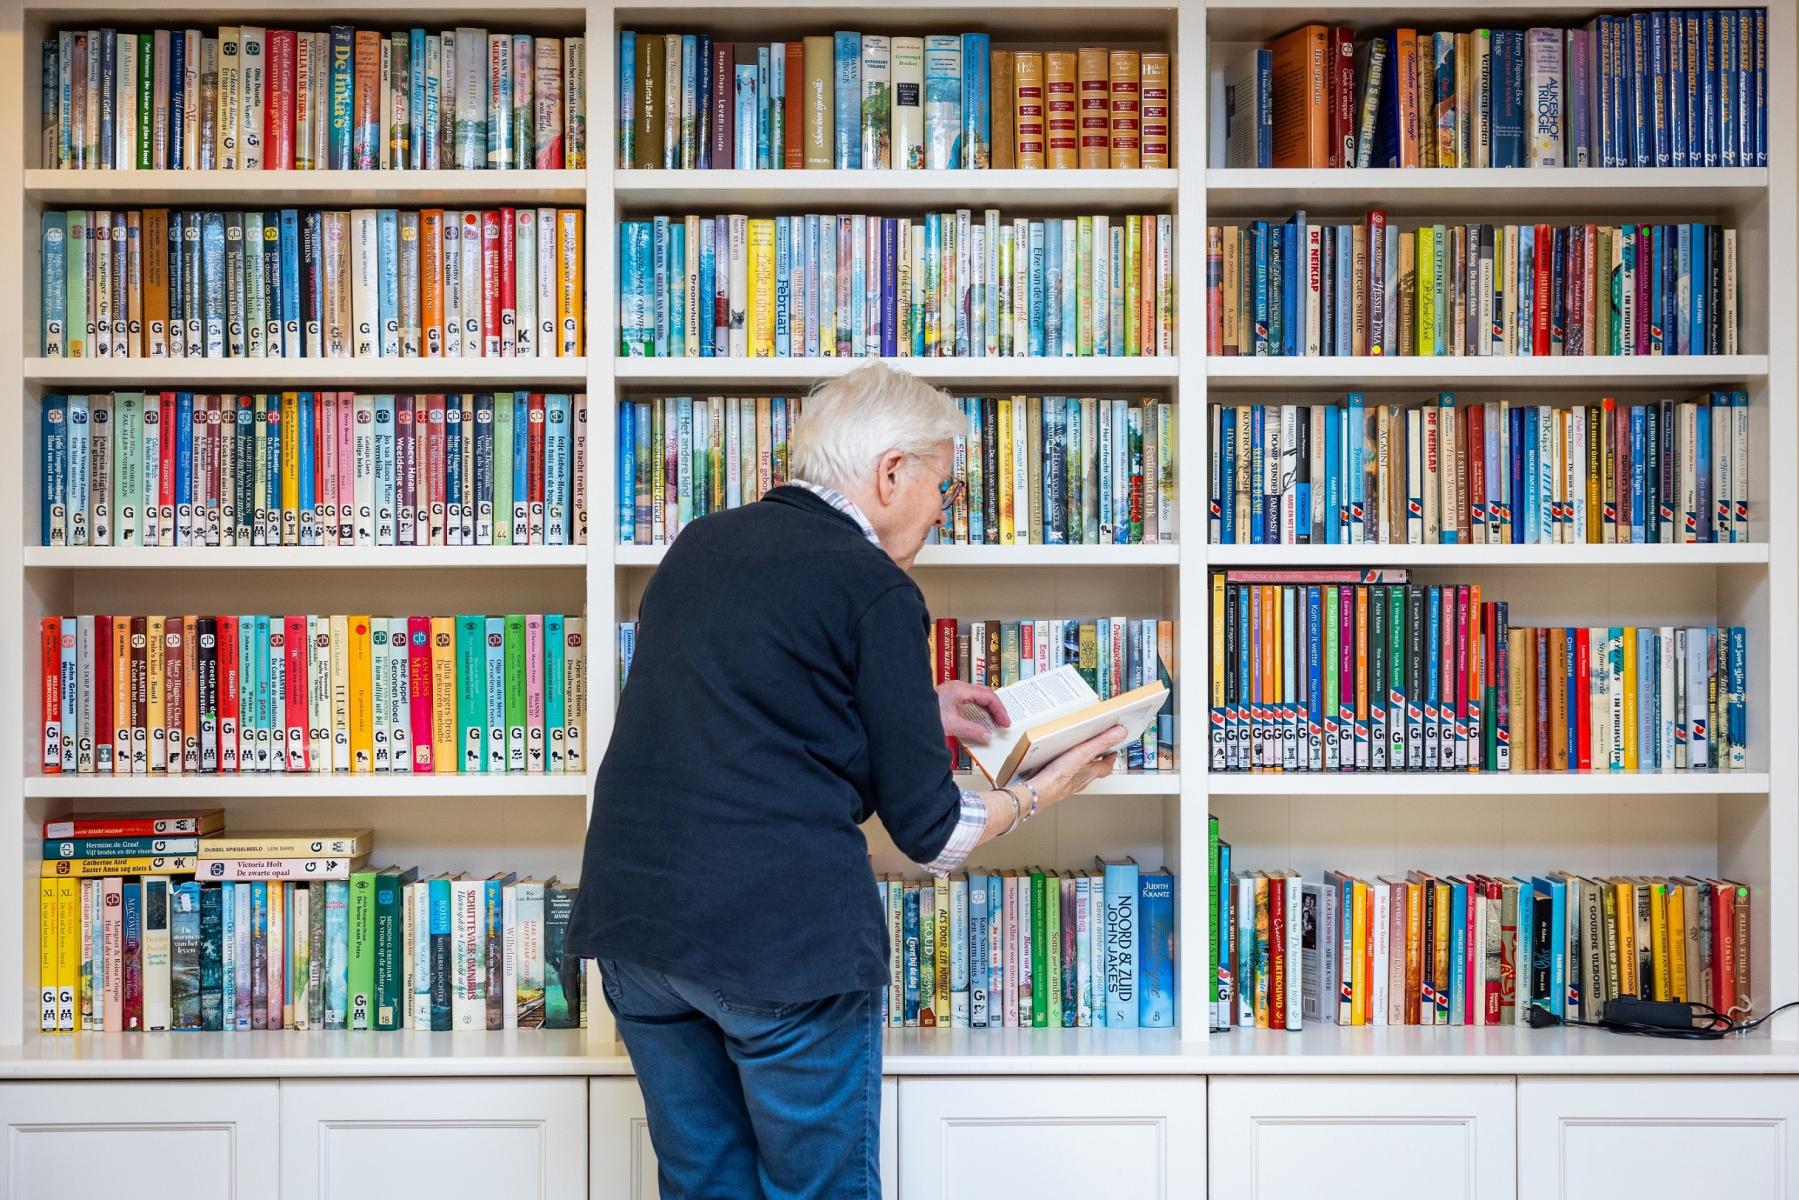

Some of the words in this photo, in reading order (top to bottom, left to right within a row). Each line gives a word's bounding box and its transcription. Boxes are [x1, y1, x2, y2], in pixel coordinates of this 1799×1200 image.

[299, 39, 307, 69] STELLA
[334, 45, 350, 69] De
[283, 58, 290, 69] de
[1408, 51, 1416, 88] Bruiden
[299, 71, 307, 79] IN
[1369, 54, 1386, 94] hyena's
[143, 81, 150, 89] De
[299, 82, 307, 91] DE
[299, 94, 307, 121] STORM
[334, 72, 350, 128] Inka's
[1367, 98, 1376, 110] op
[1408, 92, 1416, 107] van
[718, 99, 726, 123] Leven
[1538, 85, 1549, 134] TRILOGIE
[1549, 77, 1558, 141] AUKESHOF
[271, 109, 280, 135] geven
[1361, 112, 1375, 139] mijn
[1408, 112, 1416, 141] Oranje
[1311, 231, 1319, 243] DE
[1469, 230, 1477, 241] U.G.
[1469, 243, 1477, 251] de
[1469, 252, 1477, 267] Jong
[1033, 269, 1043, 284] van
[1311, 249, 1319, 292] NEIKLAP
[1469, 271, 1477, 279] De
[1033, 287, 1043, 298] de
[1371, 281, 1384, 315] HESSEL
[778, 279, 788, 336] Februari
[1033, 300, 1043, 329] koster
[152, 322, 163, 333] G
[360, 323, 370, 333] G
[518, 330, 530, 343] K
[1371, 319, 1384, 344] YPMA
[681, 417, 690, 435] Het
[92, 436, 98, 447] De
[376, 435, 382, 443] De
[576, 436, 585, 447] De
[396, 437, 404, 487] Weelderige
[576, 455, 585, 472] nacht
[681, 438, 690, 471] andere
[1146, 445, 1155, 492] Ferdinand
[576, 475, 585, 496] trekt
[681, 477, 690, 497] kind
[576, 498, 585, 509] op
[1146, 494, 1155, 506] en
[161, 508, 172, 518] G
[1146, 508, 1155, 518] ik
[1567, 637, 1573, 650] Om
[436, 660, 444, 669] De
[444, 660, 452, 678] Julia
[412, 658, 420, 697] Marleen
[436, 671, 444, 707] gekozen
[436, 710, 444, 743] melodie
[311, 842, 322, 852] G
[272, 869, 290, 877] opaal
[44, 889, 55, 897] XL
[1144, 882, 1168, 890] JUDITH
[1589, 893, 1597, 902] IT
[379, 916, 387, 925] De
[467, 890, 476, 953] SCHUTTEVAER
[894, 911, 901, 919] De
[940, 909, 948, 924] ALS
[1108, 904, 1117, 944] JOHN
[1118, 896, 1132, 949] NOORD
[971, 917, 979, 933] Een
[1590, 905, 1599, 950] GOUDENE
[379, 927, 387, 945] vrouw
[925, 921, 933, 954] GOUD
[940, 926, 948, 947] DOOR
[379, 947, 387, 956] op
[971, 935, 979, 957] warm
[379, 958, 387, 967] de
[940, 951, 948, 964] EEN
[1118, 954, 1132, 966] &
[971, 959, 979, 977] huis
[1108, 949, 1117, 993] JAKES
[1591, 953, 1600, 998] ULEBOERD
[379, 968, 387, 1006] achtergrond
[467, 958, 476, 1000] OMNIBUS
[940, 967, 948, 1000] WONDER
[1118, 969, 1132, 1001] ZUID
[382, 1016, 390, 1024] 18
